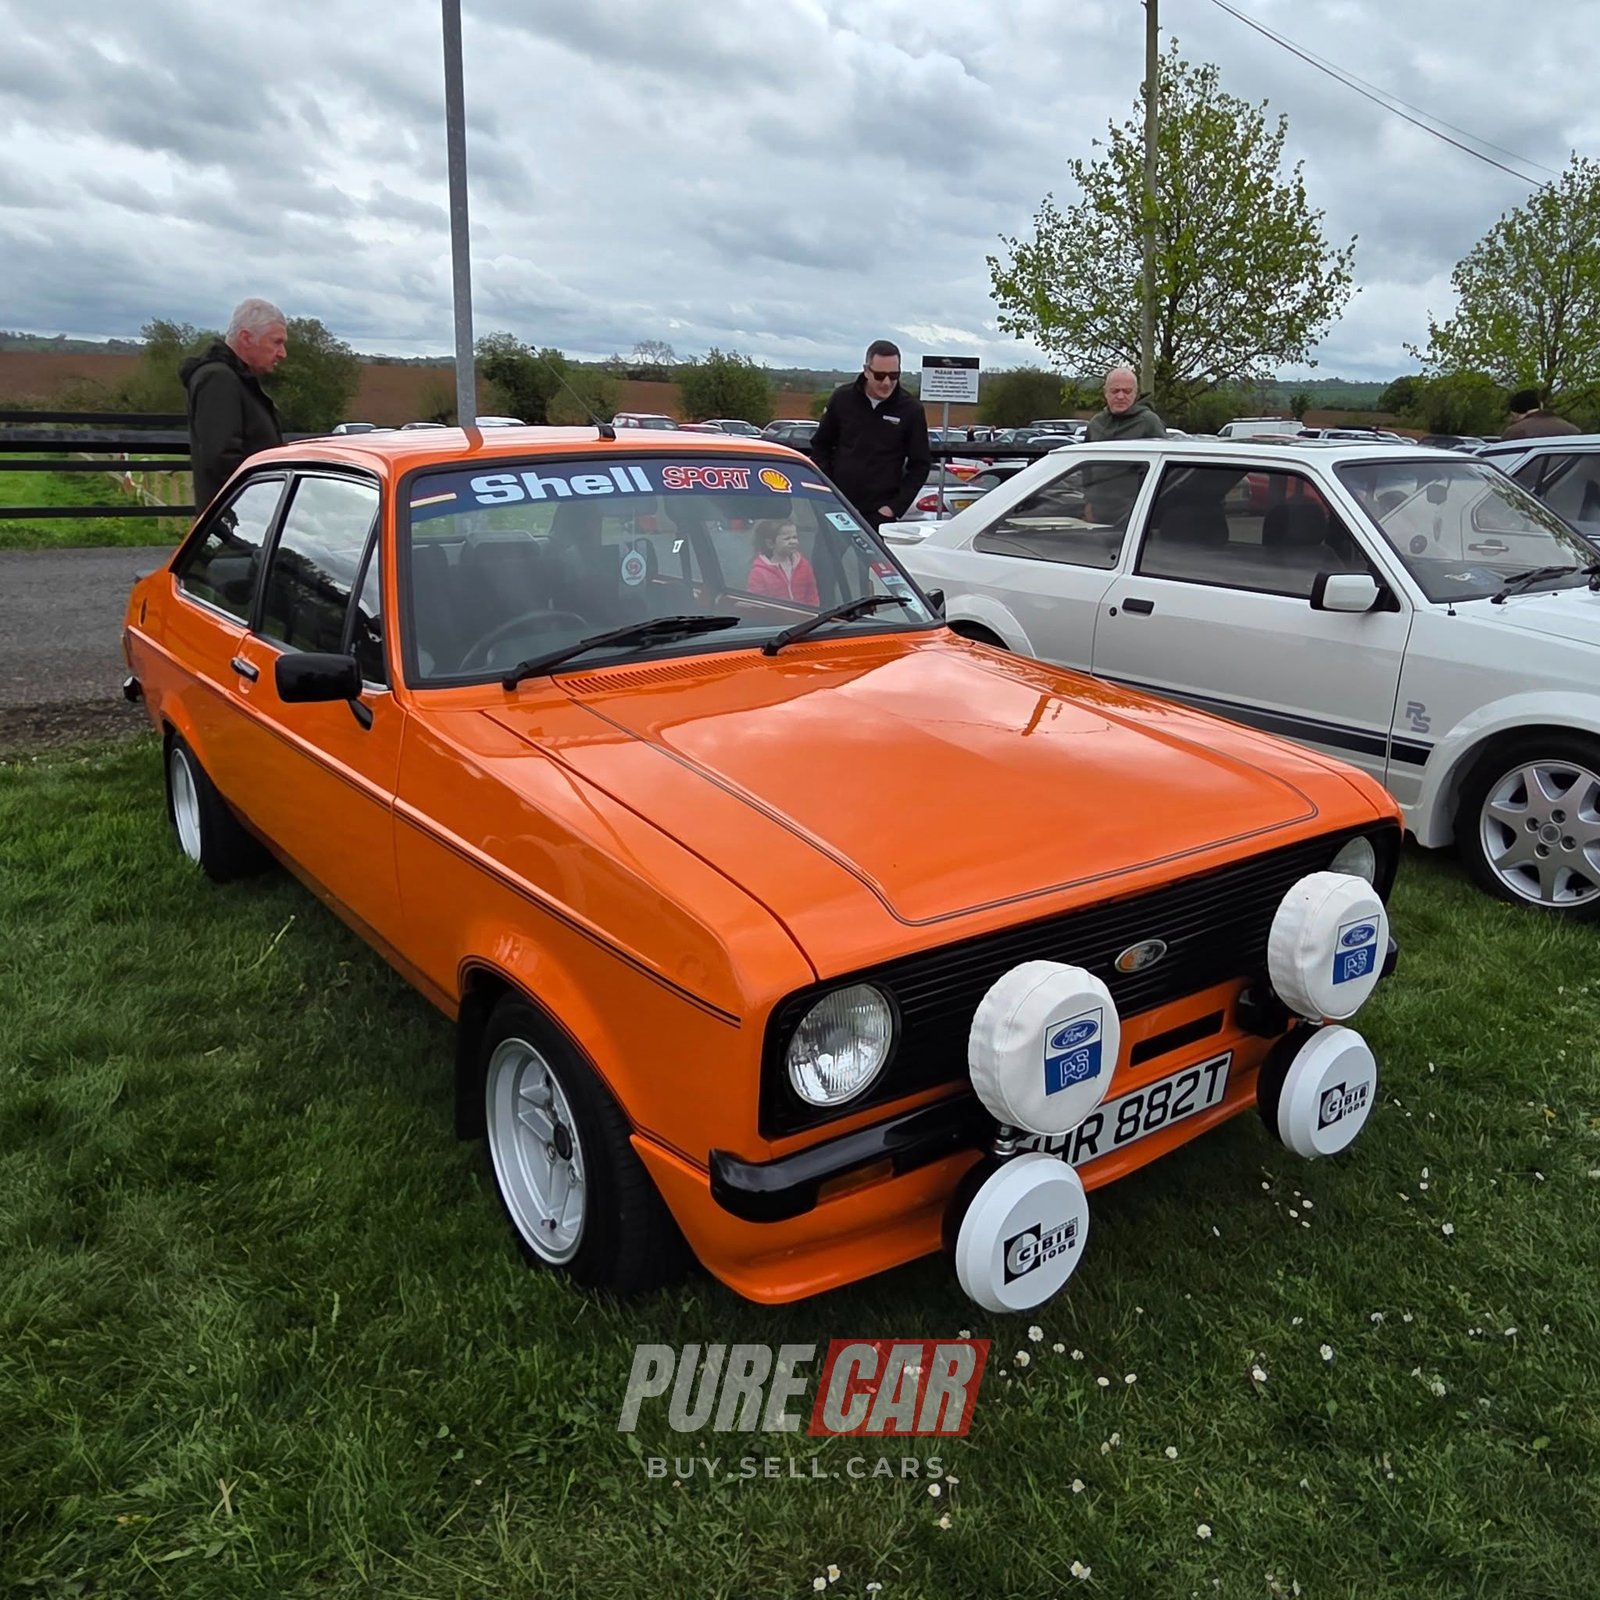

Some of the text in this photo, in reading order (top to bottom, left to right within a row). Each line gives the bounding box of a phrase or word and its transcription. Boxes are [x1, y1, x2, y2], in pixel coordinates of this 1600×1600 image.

[470, 465, 751, 505] Shell SPORT
[1405, 700, 1432, 734] RS
[1344, 948, 1368, 980] RS
[1061, 1025, 1089, 1046] Ford
[1059, 1048, 1090, 1088] RS
[1032, 1057, 1229, 1164] HR 882T
[1329, 1086, 1367, 1113] CIBIE
[1343, 1099, 1366, 1117] IODE
[1018, 1224, 1076, 1262] CIBIE
[1042, 1238, 1076, 1263] IODE
